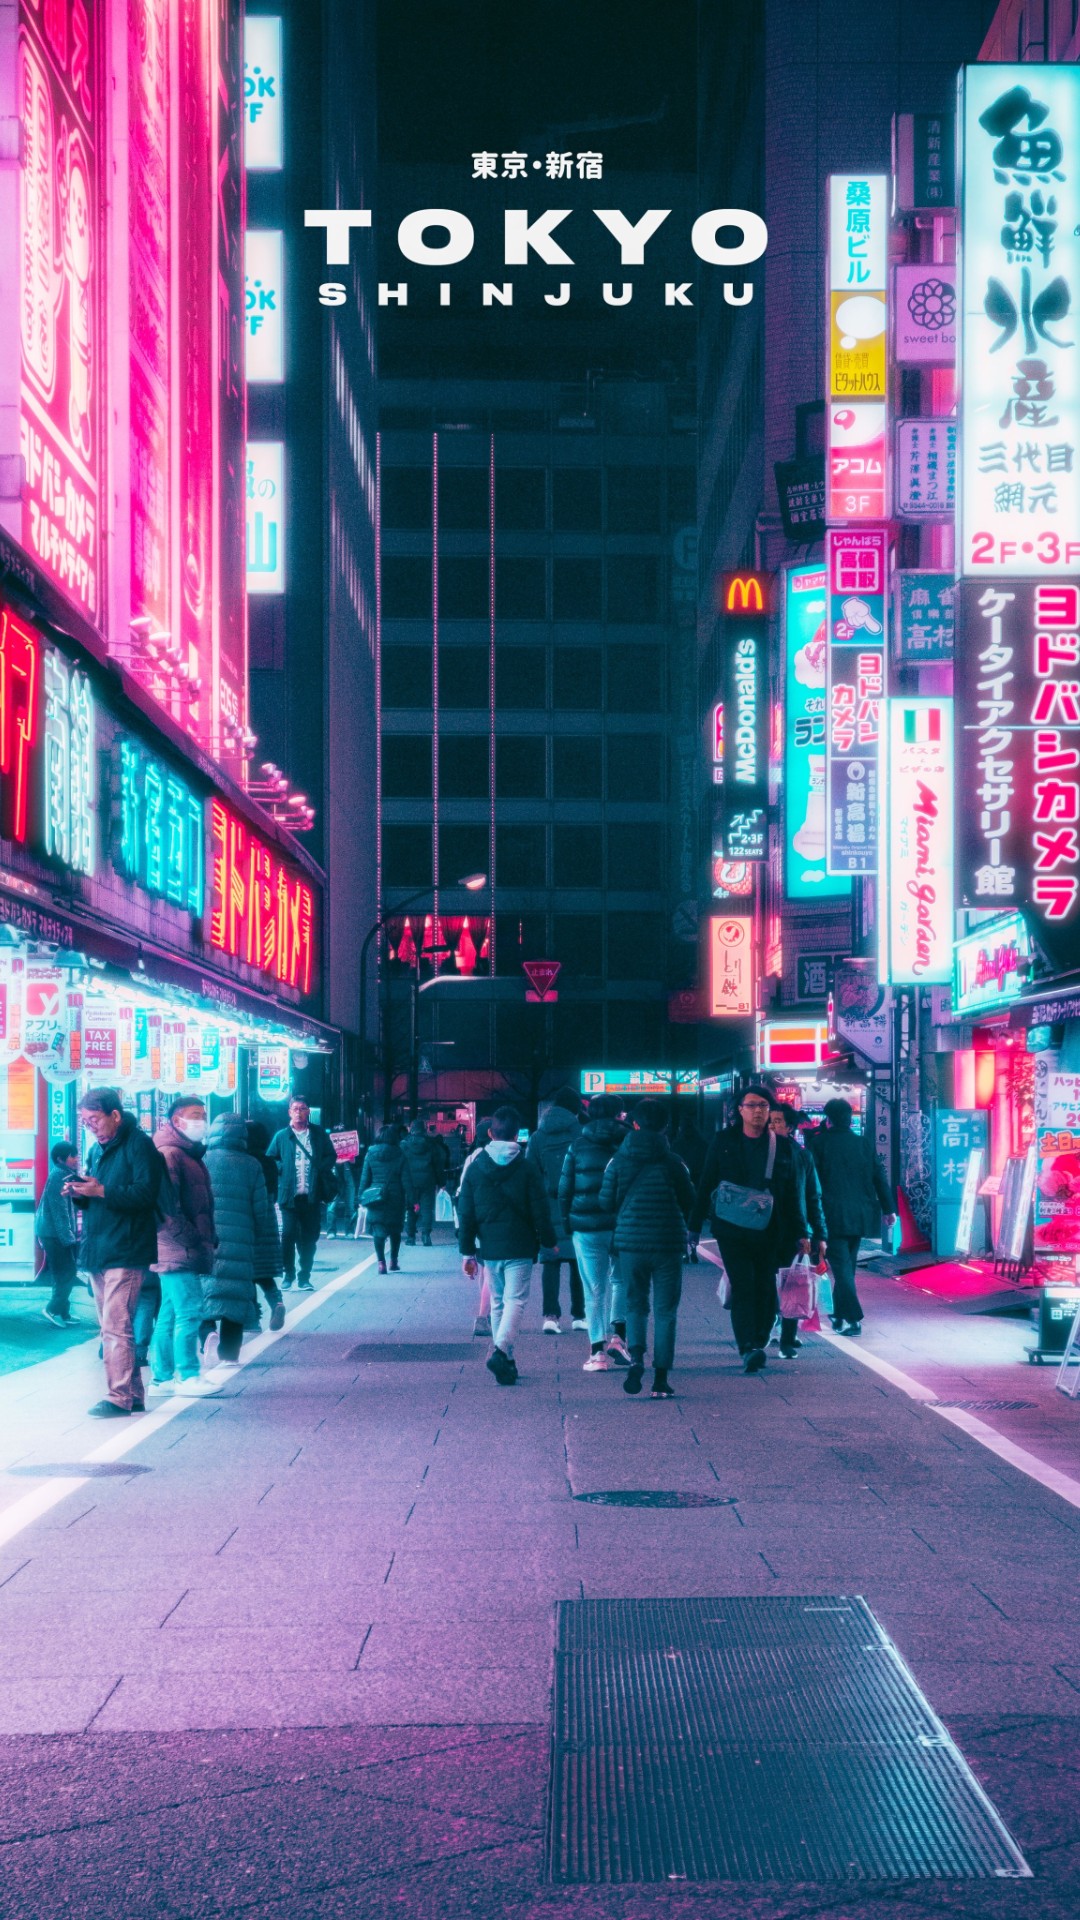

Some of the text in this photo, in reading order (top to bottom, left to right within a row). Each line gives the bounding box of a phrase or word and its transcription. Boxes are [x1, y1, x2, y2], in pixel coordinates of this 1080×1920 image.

[846, 181, 872, 284] 桑原ビル
[979, 85, 1075, 429] 魚鮮水産
[903, 334, 939, 344] sweet
[832, 458, 882, 475] アコム
[977, 441, 1075, 474] 三代目
[844, 495, 870, 513] 3F
[993, 481, 1058, 514] 網元
[836, 621, 855, 638] 2F
[735, 638, 756, 785] McDonald's
[857, 652, 881, 744] ヨドバシ
[832, 683, 857, 752] カメラ
[975, 588, 1015, 896] ケータイアクセサリー館
[1031, 584, 1080, 919] ヨドバシカメラ
[728, 847, 745, 856] 122
[210, 799, 313, 994] ヨドバシカメラ
[713, 886, 730, 898] 4F
[803, 961, 826, 994] 酒
[85, 1041, 113, 1051] FREE
[87, 1030, 111, 1041] TAX
[588, 1073, 601, 1091] P
